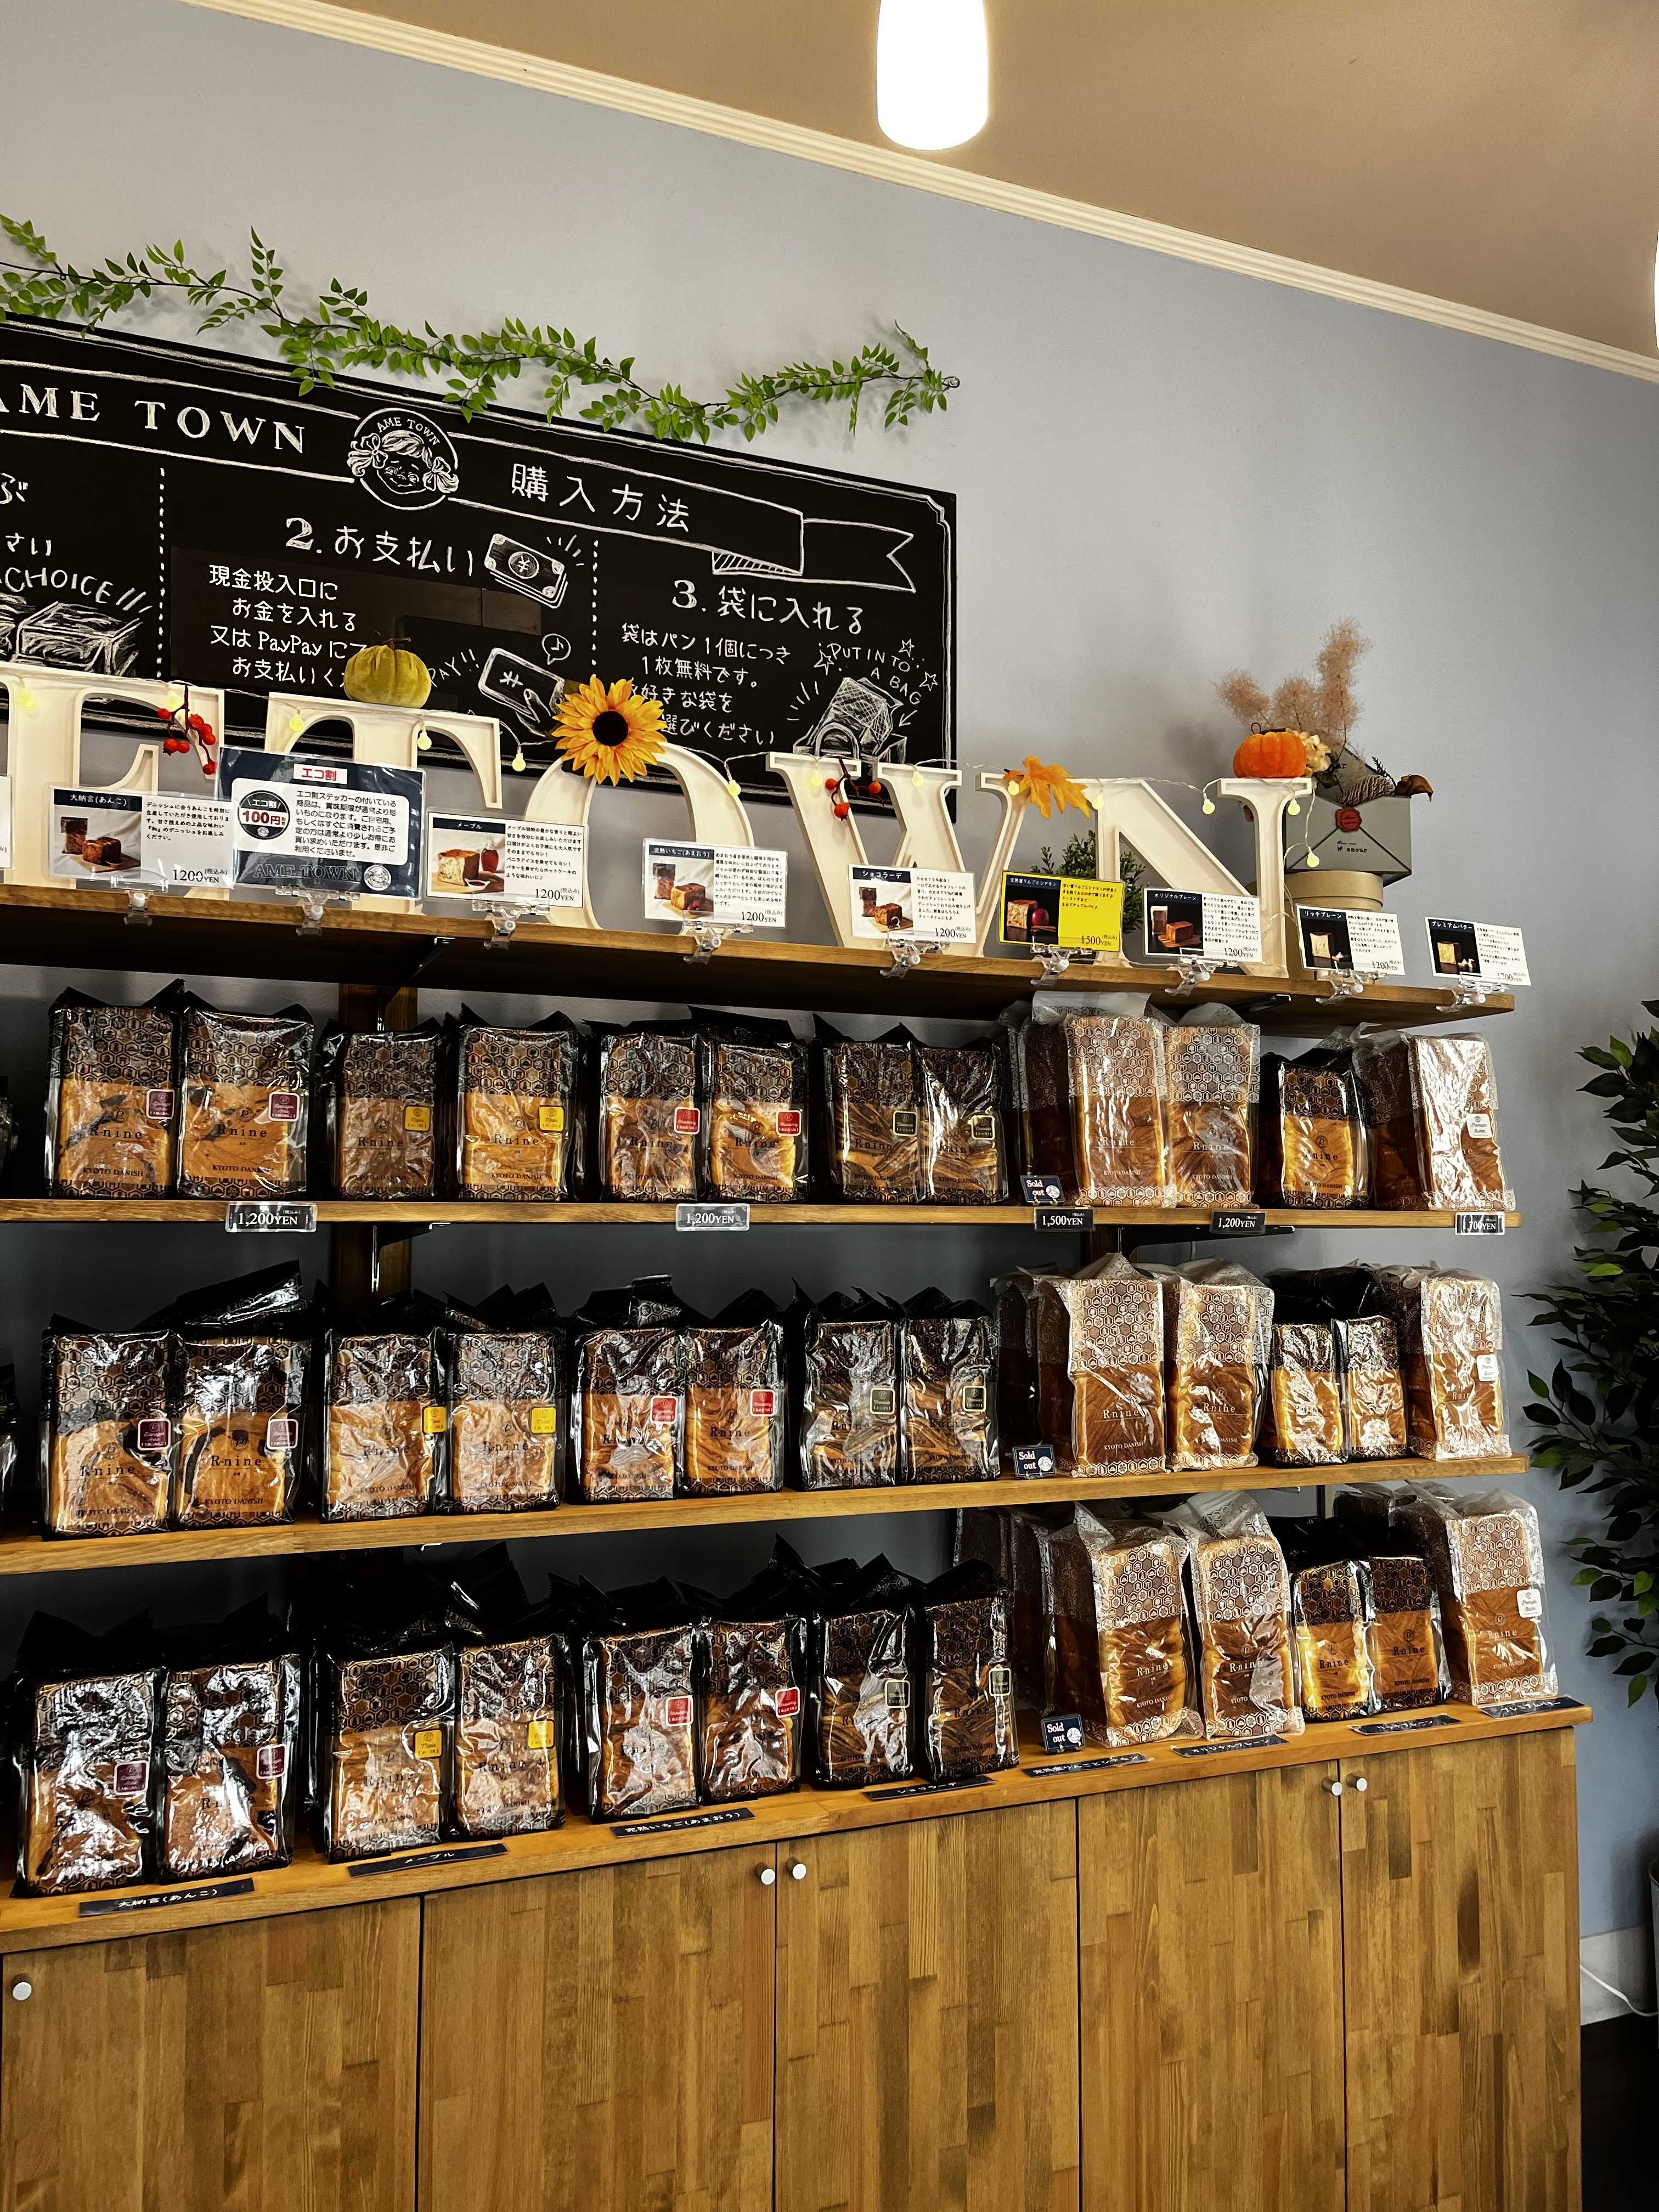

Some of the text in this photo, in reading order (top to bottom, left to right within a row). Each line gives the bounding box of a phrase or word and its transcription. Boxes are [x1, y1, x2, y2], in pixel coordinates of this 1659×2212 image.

[134, 400, 305, 454] TOWN
[377, 417, 440, 445] AME TOWN
[512, 464, 690, 532] 購入方法
[5, 533, 52, 556] さい
[335, 527, 473, 576] お支払い
[209, 565, 338, 600] 現金投入口に
[233, 597, 356, 631] お金を入れる
[719, 585, 864, 635] 袋に入れる
[258, 631, 322, 657] PayPay
[827, 643, 911, 672] PUT IN TO
[233, 657, 345, 689] お支払いく
[642, 656, 757, 688] 1枚無料です。
[871, 667, 922, 705] A BAG
[631, 678, 733, 713] 好きな袋を
[302, 768, 336, 781] エコ割
[70, 794, 127, 806] 大納言(あんこ)
[297, 790, 396, 808] エコ割ステッカーの付いている
[295, 845, 356, 857] 利用くださいませ。
[862, 871, 902, 879] ショコラーデ
[1305, 911, 1342, 919] リッチプレーン
[1026, 1180, 1042, 1188] Sold
[238, 1212, 297, 1226] 1,200YEN
[686, 1212, 734, 1224] 1,200YEN
[1042, 1215, 1082, 1226] 1,500YEN
[1218, 1217, 1255, 1228] 1,200YEN
[1103, 1409, 1138, 1419] R-nine
[211, 1455, 262, 1466] R-nine
[1019, 1451, 1035, 1460] Sold
[1319, 1659, 1348, 1669] R-nine
[1047, 1723, 1064, 1733] Sold
[1053, 1734, 1065, 1743] out
